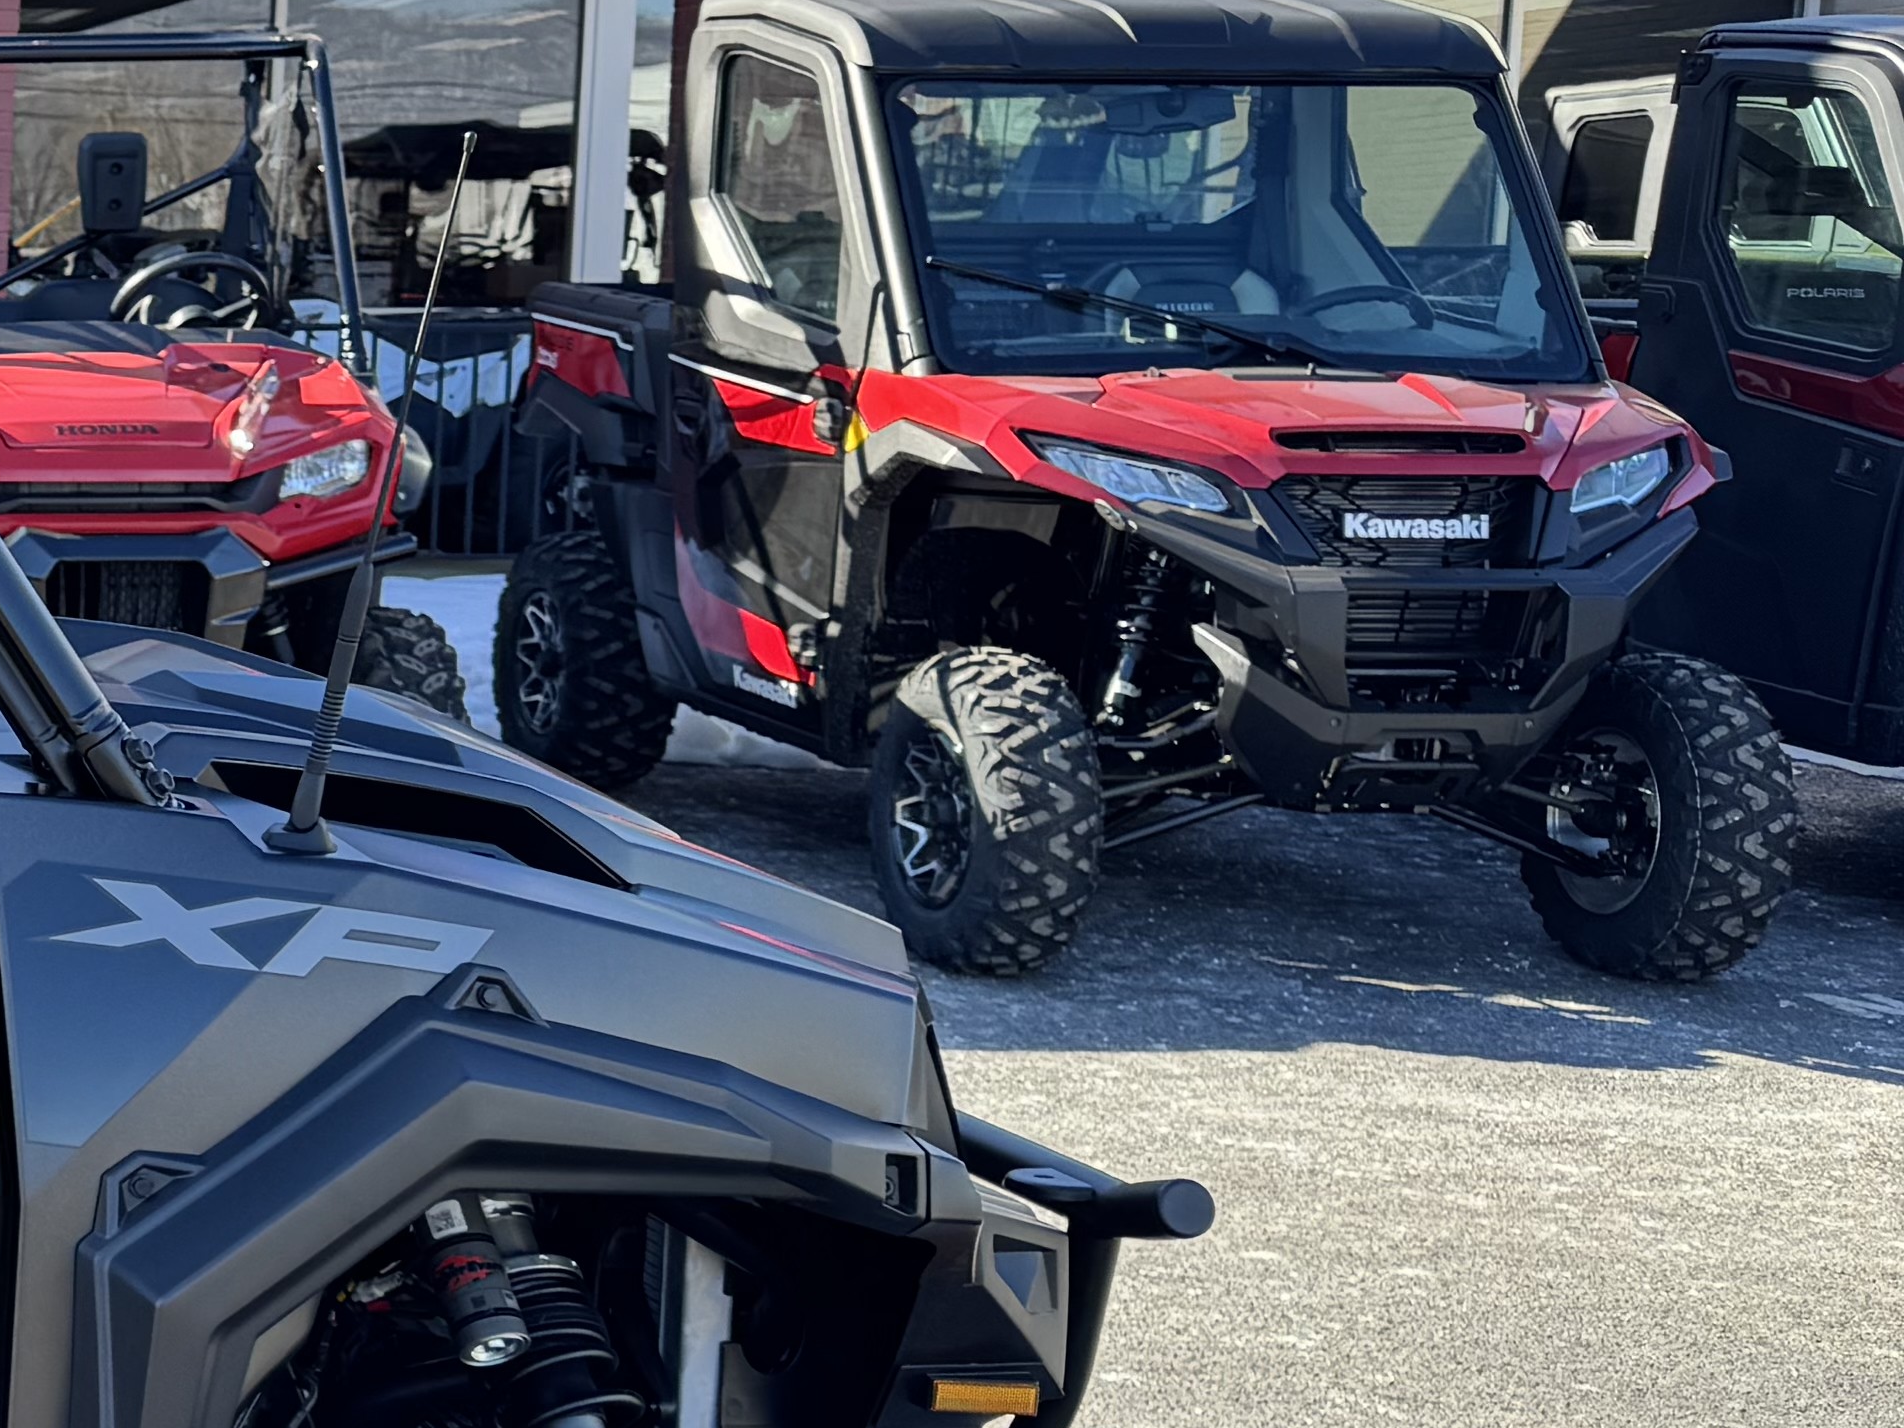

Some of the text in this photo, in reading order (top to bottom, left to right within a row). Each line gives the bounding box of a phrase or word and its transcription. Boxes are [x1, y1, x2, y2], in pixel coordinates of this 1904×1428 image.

[1786, 287, 1866, 299] POLARIS
[55, 423, 161, 436] HONDA
[1343, 512, 1491, 541] Kawasaki
[48, 876, 495, 978] XP
